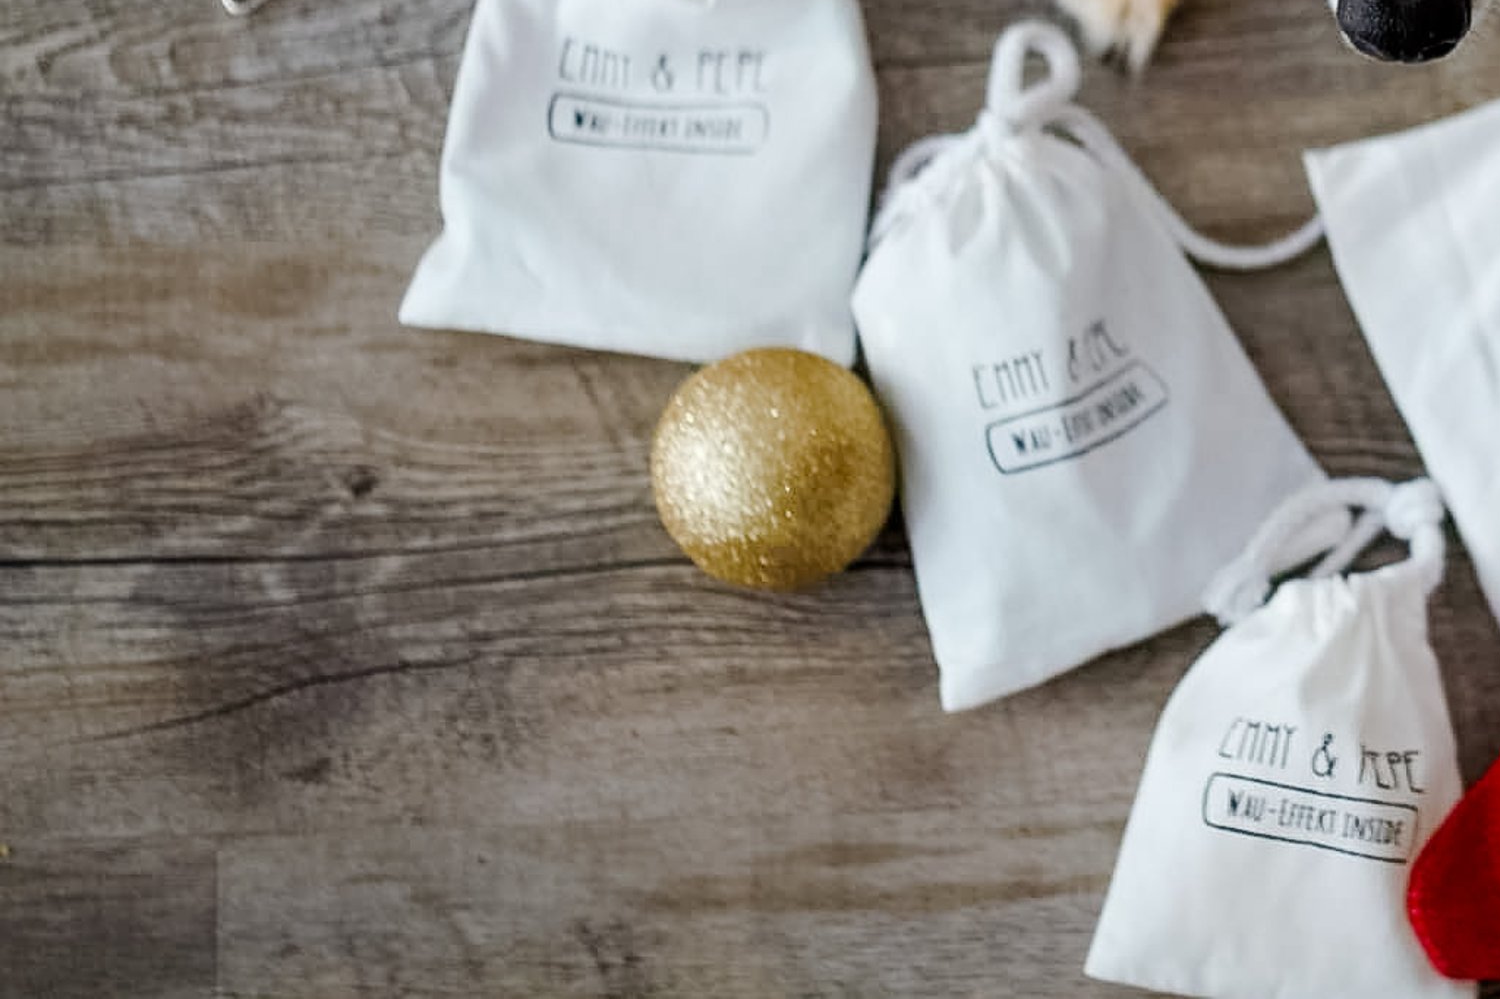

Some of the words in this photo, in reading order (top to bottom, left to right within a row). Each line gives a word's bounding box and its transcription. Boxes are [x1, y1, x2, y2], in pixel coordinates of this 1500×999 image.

[651, 52, 675, 94] &
[697, 45, 768, 96] PEPE
[973, 349, 1049, 410] EMMY
[1218, 716, 1297, 770] EMMY
[1312, 733, 1337, 778] &
[1227, 787, 1337, 834] WAU-EFFEKT
[1342, 812, 1405, 846] INSIDE
